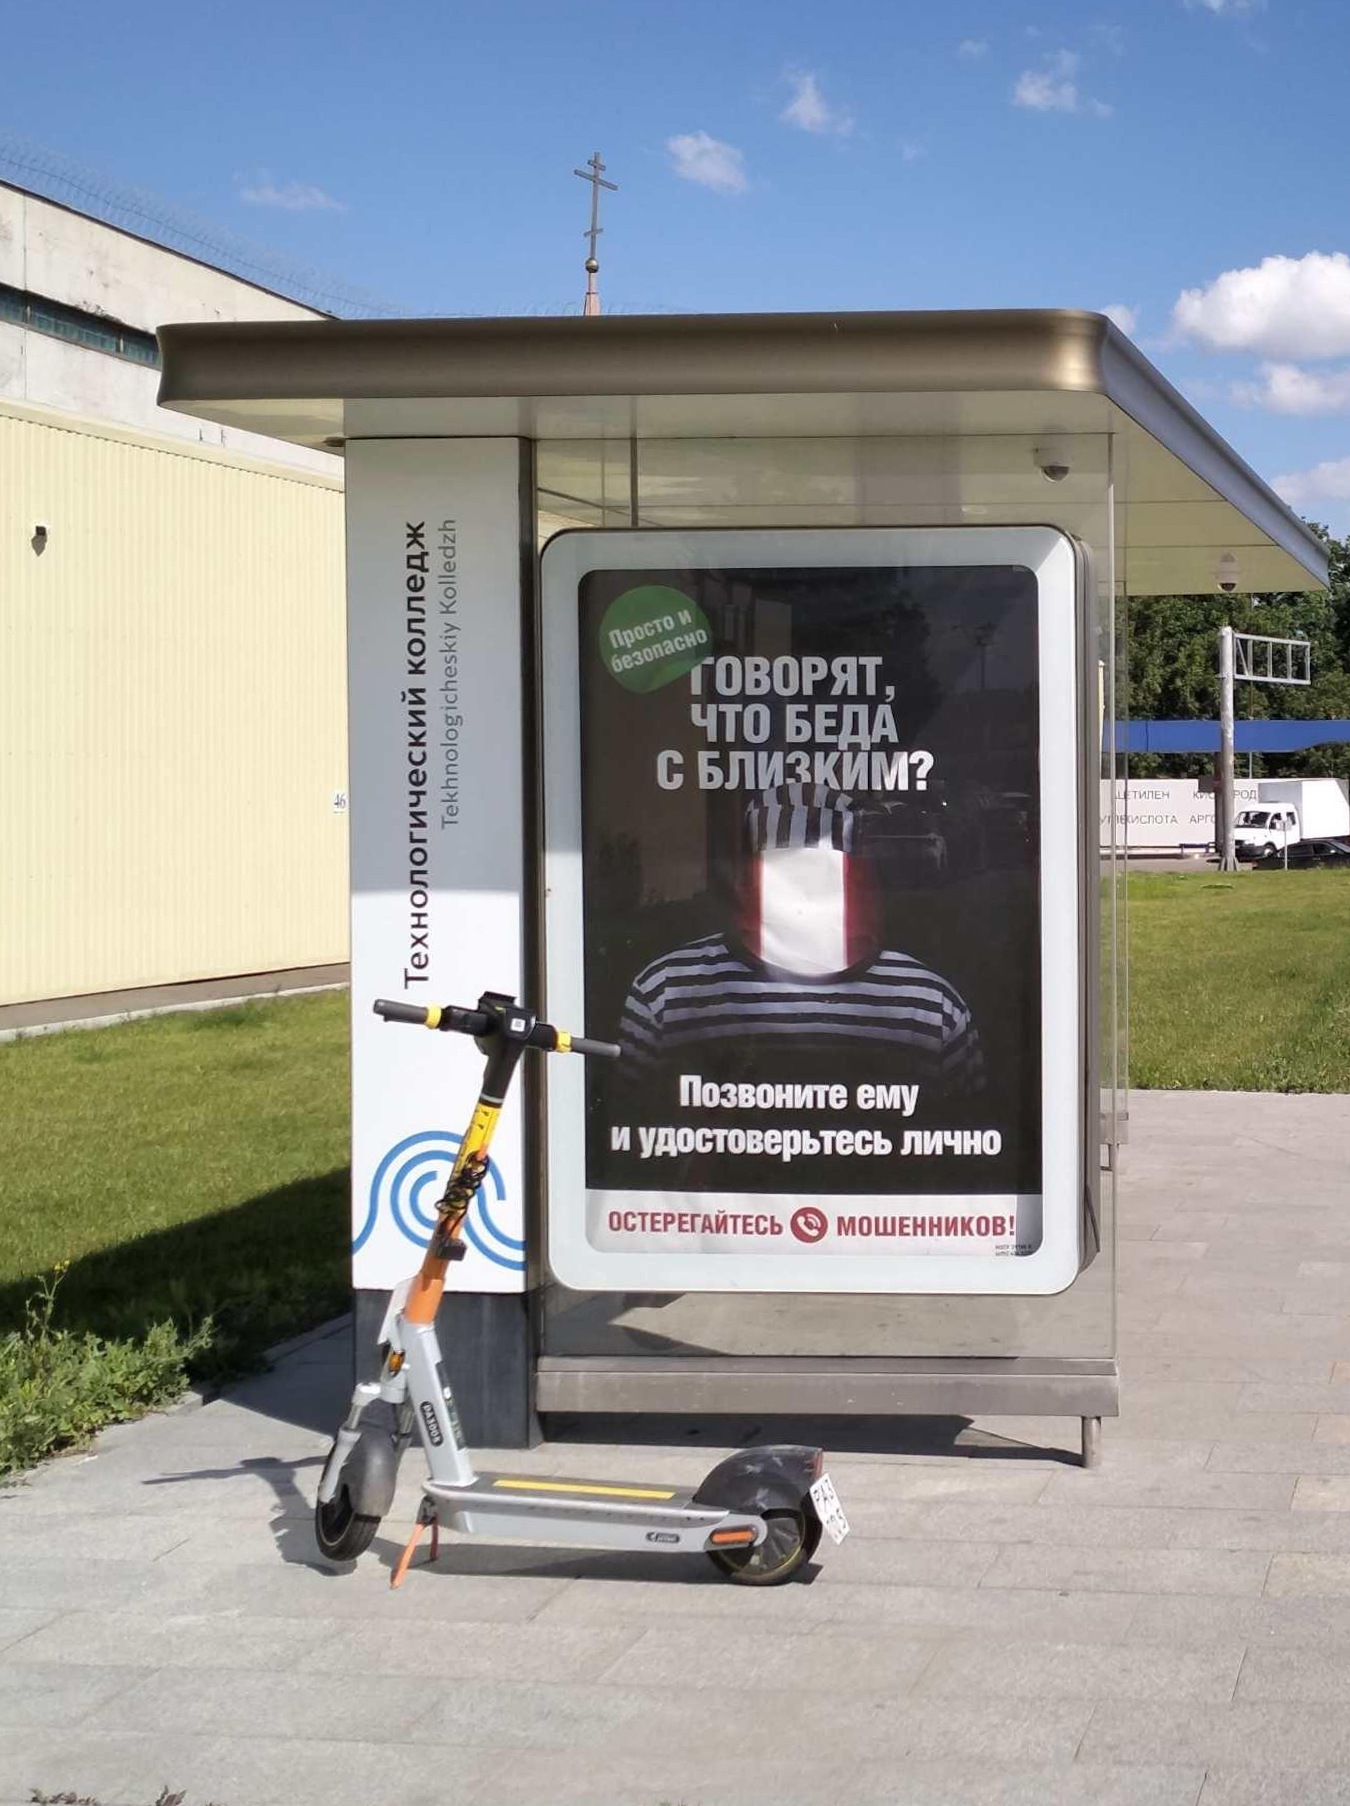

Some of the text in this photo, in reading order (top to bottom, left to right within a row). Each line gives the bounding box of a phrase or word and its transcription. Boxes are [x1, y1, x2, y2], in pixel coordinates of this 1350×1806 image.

[609, 609, 692, 649] Просто и
[611, 628, 708, 673] безопасно
[437, 520, 463, 829] Tekhnologicheskiy Kolledzh
[690, 656, 895, 702] ГОВОРЯТ,
[691, 704, 899, 750] ЧТО БЕДА
[401, 521, 430, 989] Технологический колледж
[657, 750, 934, 790] С БЛИЗКИМ?
[680, 1075, 919, 1116] Позвоните ему
[611, 1126, 1001, 1162] и удостоверьтесь лично
[608, 1209, 1015, 1237] ОСТЕРЕГАЙТЕСЬ МОШЕННИКОВ!
